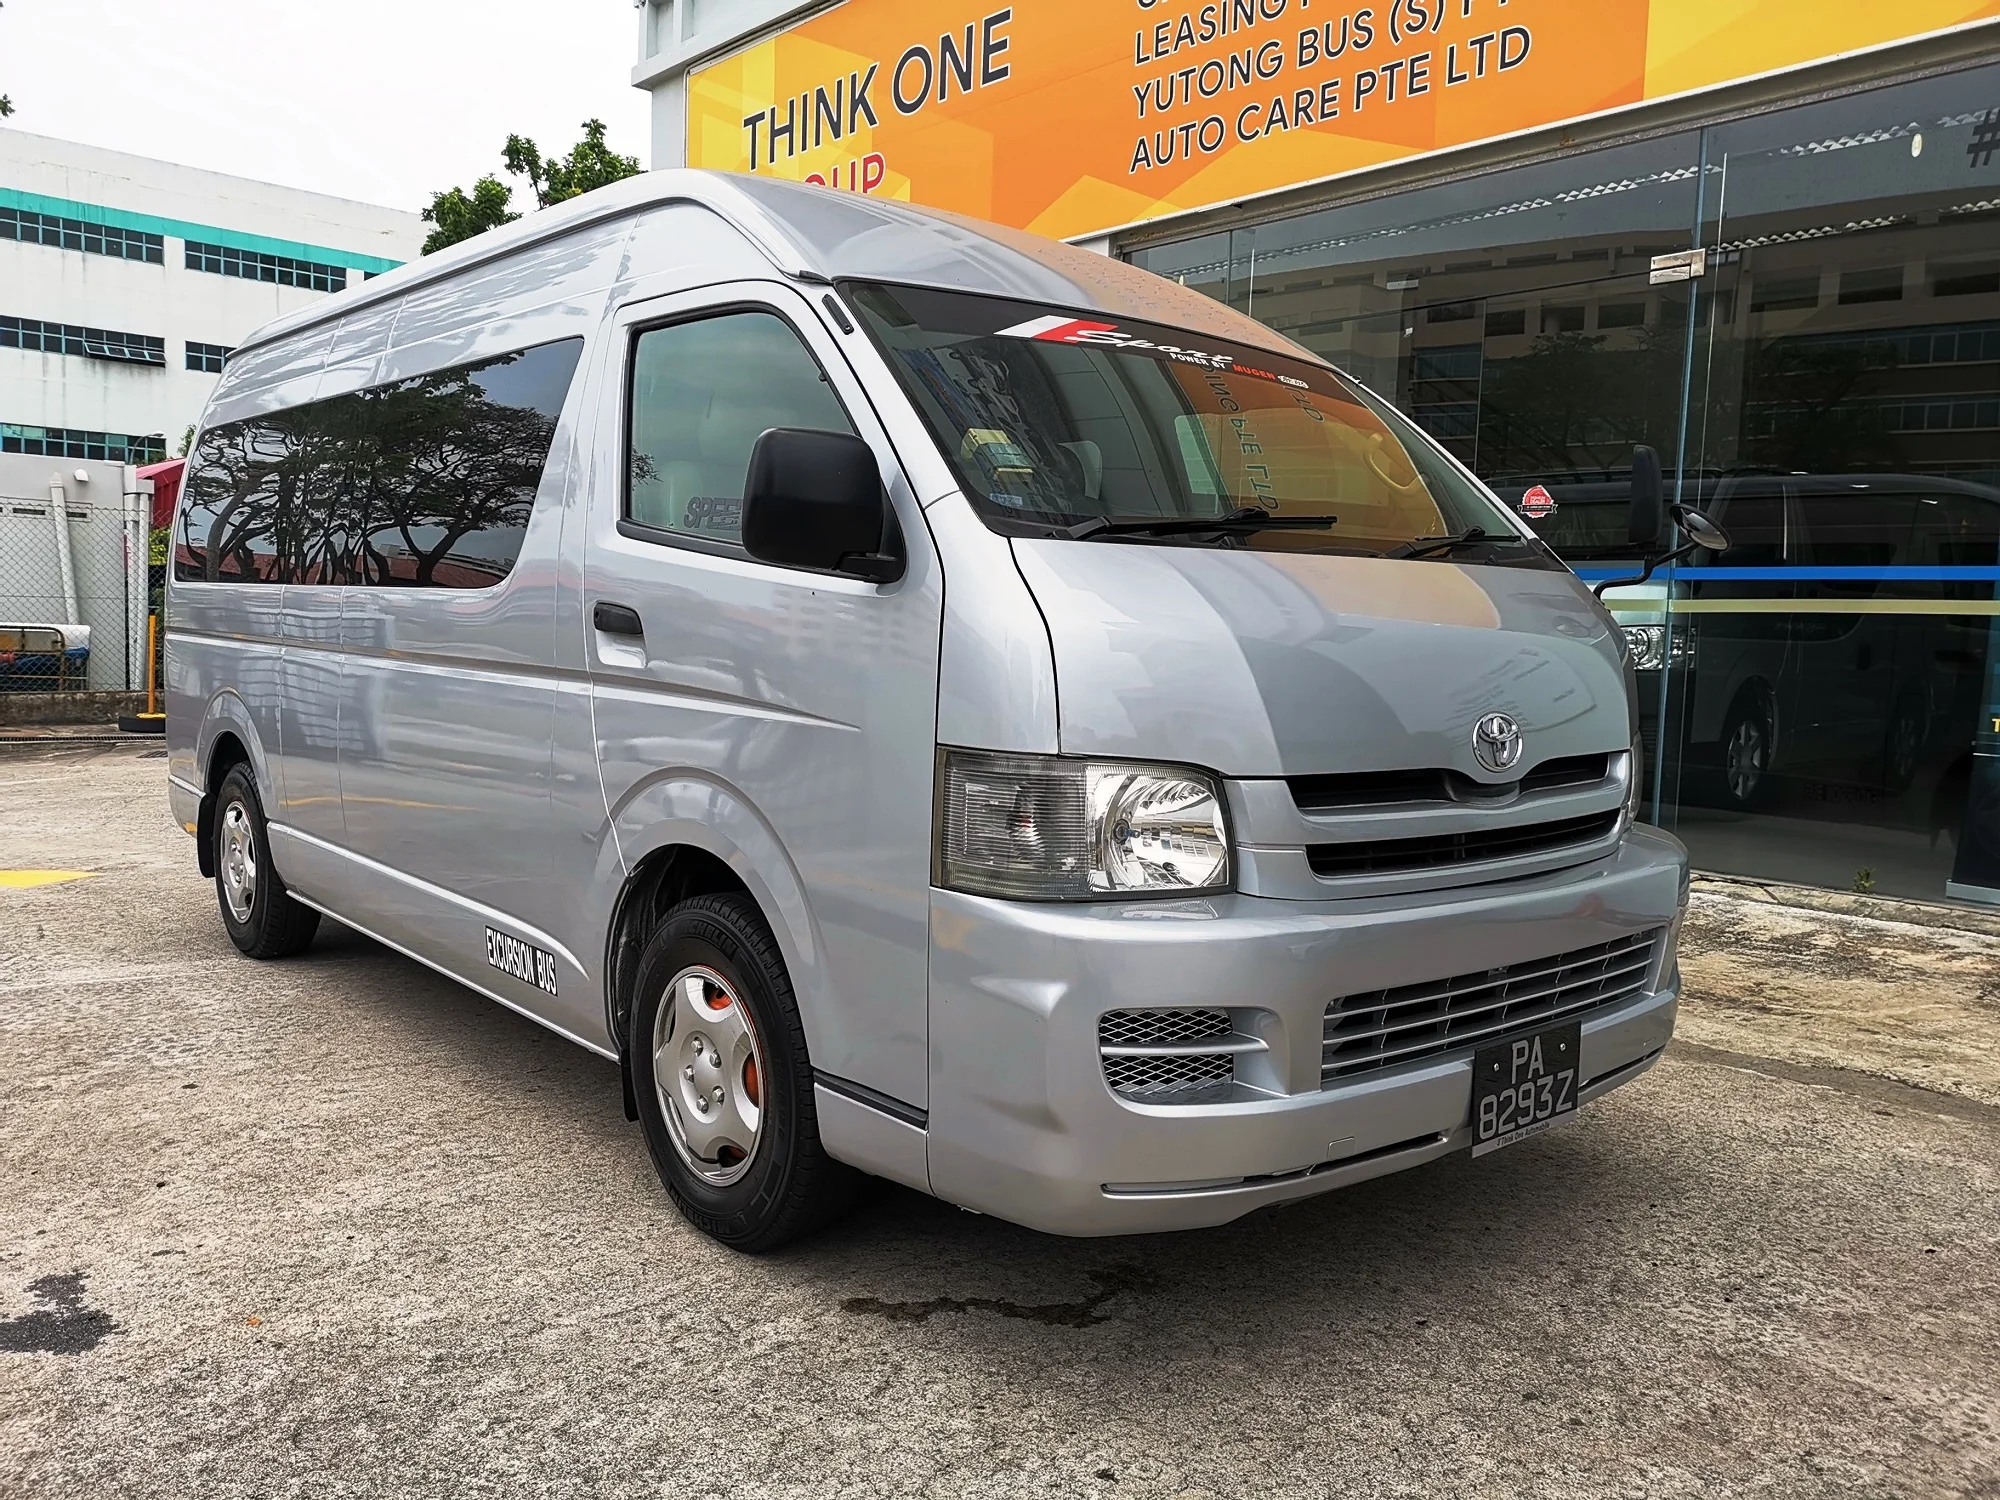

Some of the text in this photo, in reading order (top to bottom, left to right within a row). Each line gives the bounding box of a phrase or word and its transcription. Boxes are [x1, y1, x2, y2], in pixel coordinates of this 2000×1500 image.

[1134, 42, 1282, 116] YUTONG
[1298, 10, 1372, 68] BUS
[1136, 0, 1286, 63] LEASING
[744, 10, 1012, 170] THINK ONE
[1131, 27, 1530, 171] AUTO CARE PTE LTD
[1169, 352, 1276, 380] POWER BY MUGEN
[683, 496, 742, 531] SPEE
[486, 927, 557, 995] EXCURSION BUS
[1511, 1035, 1544, 1084] PA
[1479, 1068, 1574, 1140] 8293Z
